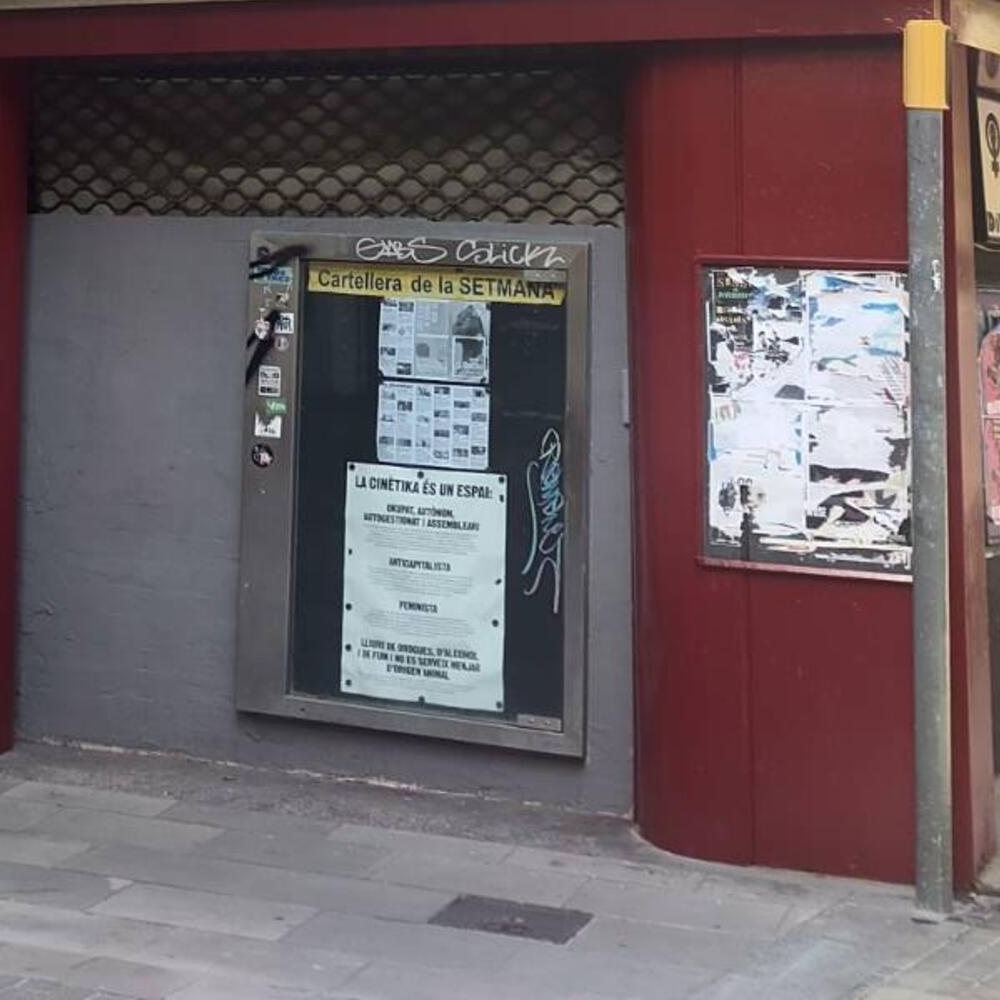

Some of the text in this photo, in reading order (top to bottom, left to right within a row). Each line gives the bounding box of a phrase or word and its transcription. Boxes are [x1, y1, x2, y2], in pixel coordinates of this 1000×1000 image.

[318, 269, 555, 299] Cartellera de la SETMANA
[355, 475, 367, 488] LA
[423, 479, 437, 495] ÉS
[440, 483, 455, 497] UN
